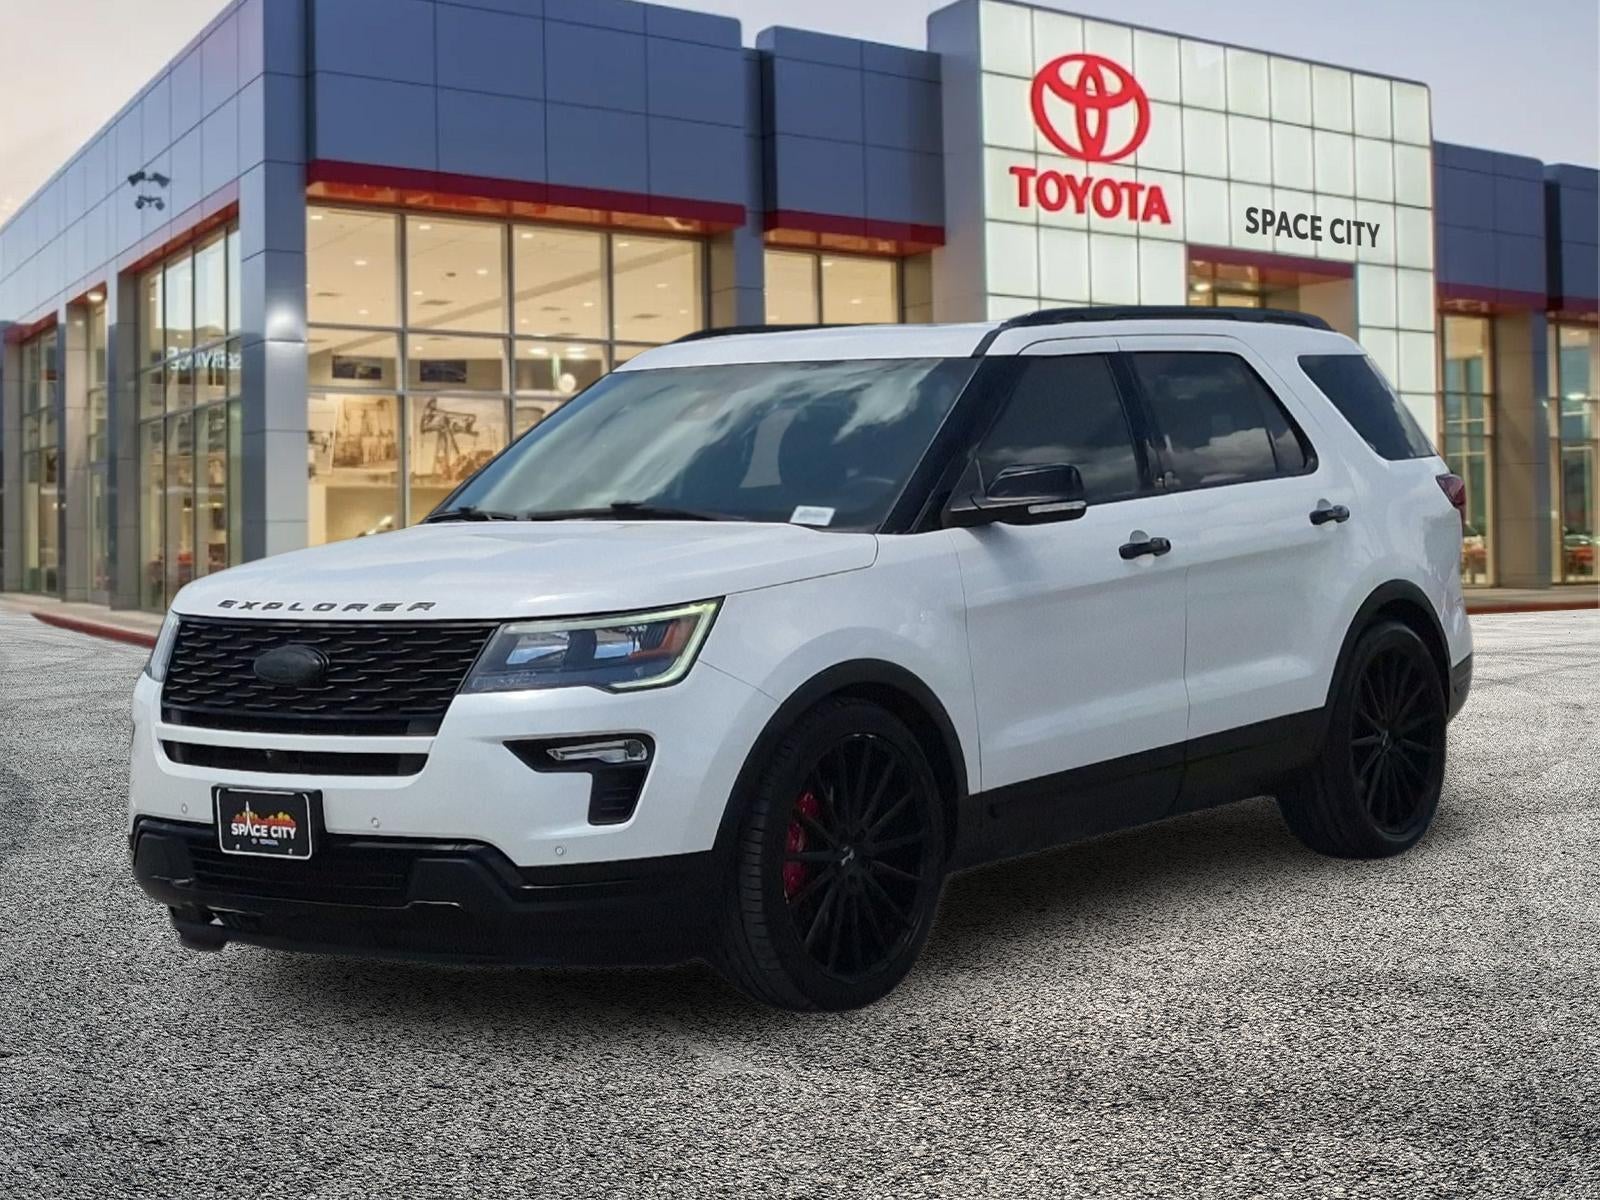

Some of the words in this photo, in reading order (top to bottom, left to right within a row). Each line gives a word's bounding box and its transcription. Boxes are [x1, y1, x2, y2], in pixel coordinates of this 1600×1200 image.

[1009, 166, 1171, 225] TOYOTA
[1245, 206, 1322, 242] SPACE
[1328, 217, 1381, 248] CITY
[217, 599, 437, 613] EXPLORER
[231, 823, 268, 837] SPACE
[271, 826, 297, 839] CITY
